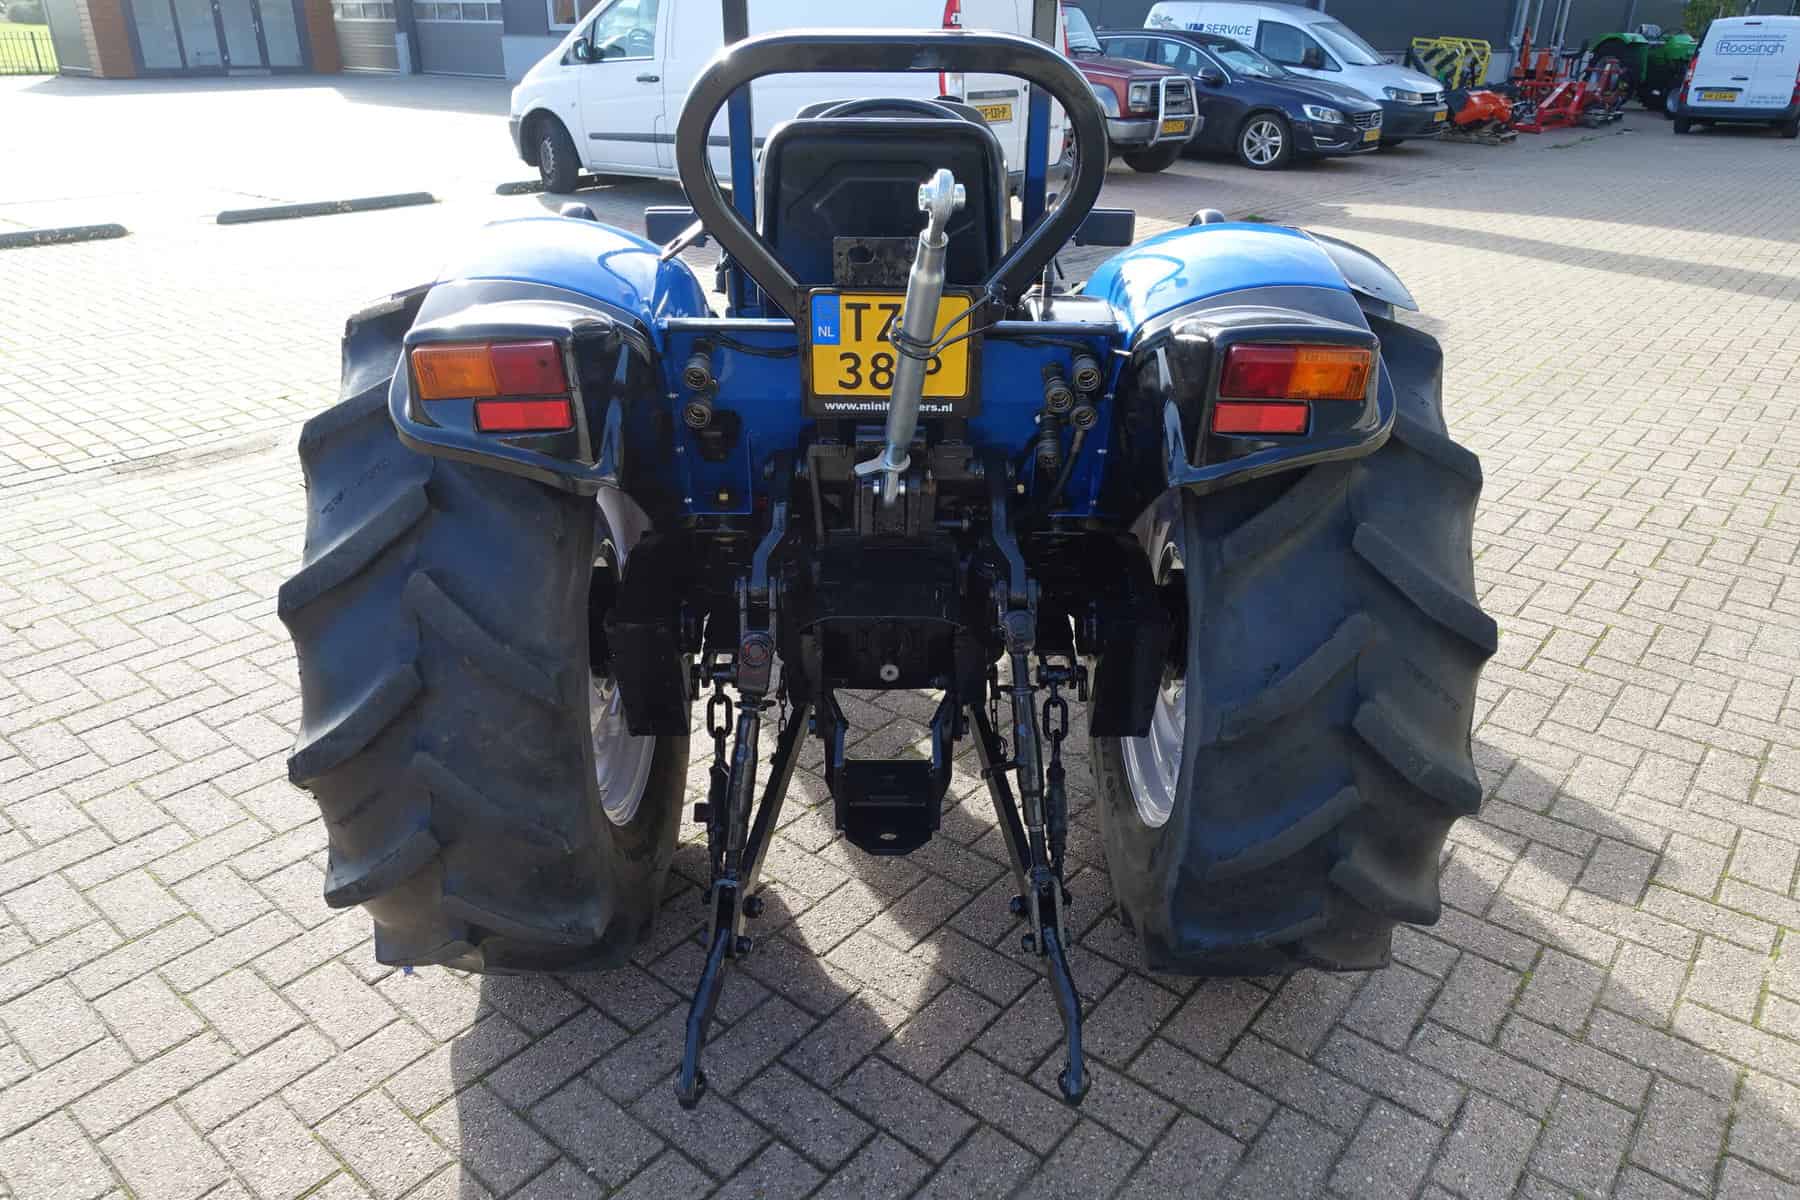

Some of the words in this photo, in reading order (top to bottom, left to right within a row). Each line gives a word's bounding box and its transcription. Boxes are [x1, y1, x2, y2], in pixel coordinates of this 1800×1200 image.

[1205, 23, 1254, 36] SERVICE
[1719, 41, 1785, 56] Roosingh
[845, 302, 906, 342] TZ
[817, 326, 835, 337] NL
[824, 401, 953, 412] www.miniters.nl
